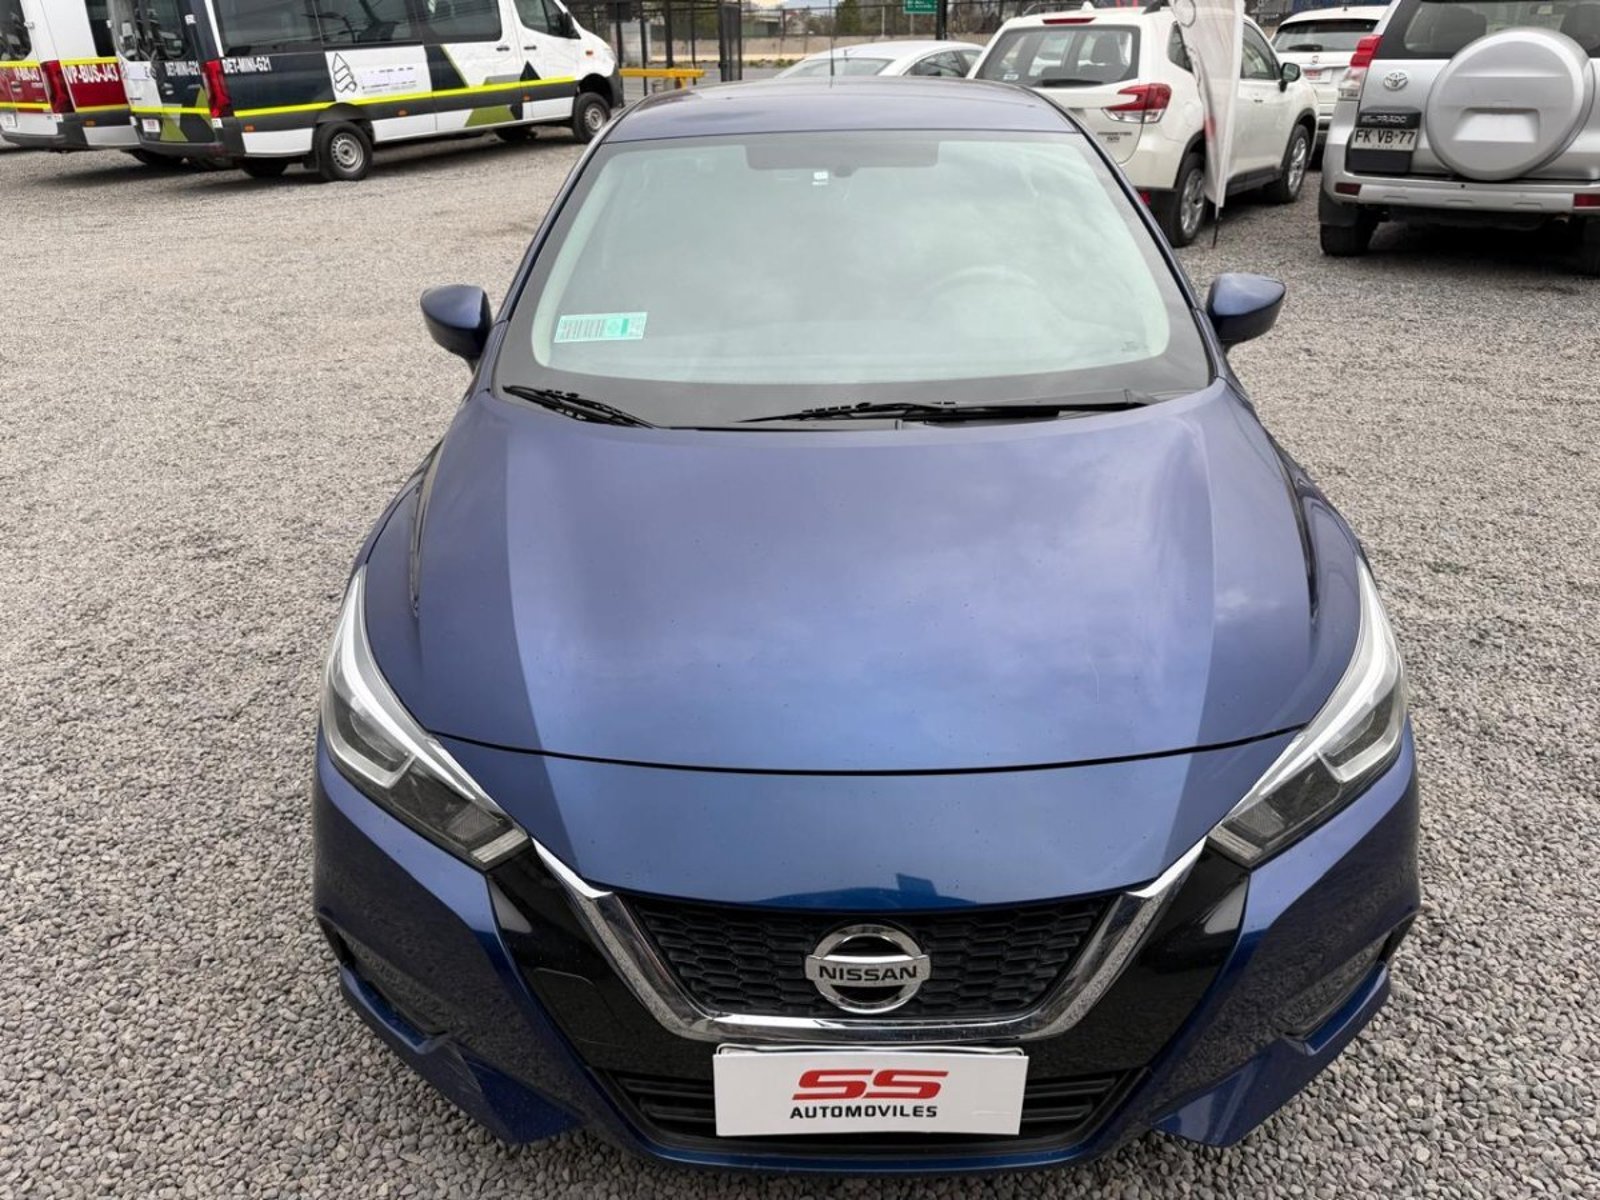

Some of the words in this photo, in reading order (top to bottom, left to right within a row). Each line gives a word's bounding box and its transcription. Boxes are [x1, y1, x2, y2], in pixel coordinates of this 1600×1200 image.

[1355, 129, 1372, 143] FK
[819, 965, 917, 981] NISSAN
[791, 1069, 950, 1101] SS
[789, 1104, 938, 1119] AUTOMOVILES
